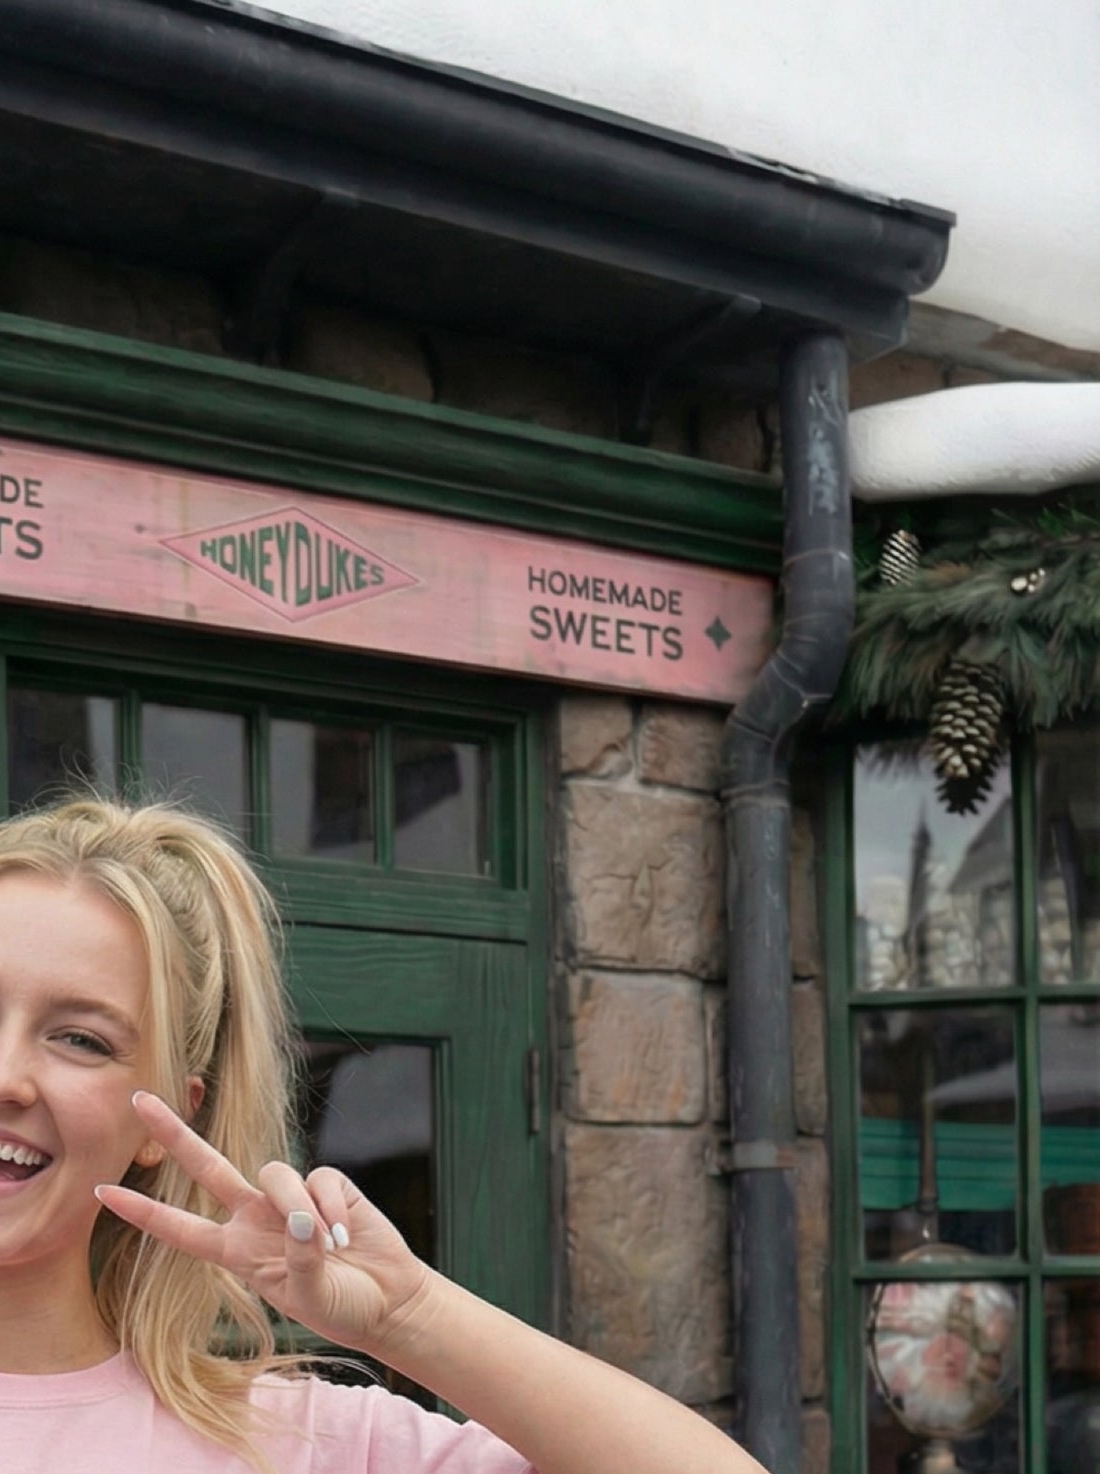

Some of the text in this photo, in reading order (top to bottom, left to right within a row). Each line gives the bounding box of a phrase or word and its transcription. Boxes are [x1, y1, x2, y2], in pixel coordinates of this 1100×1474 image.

[200, 520, 386, 607] HONEYDUKES
[528, 566, 683, 616] HOMEMADE
[530, 605, 683, 661] SWEETS
